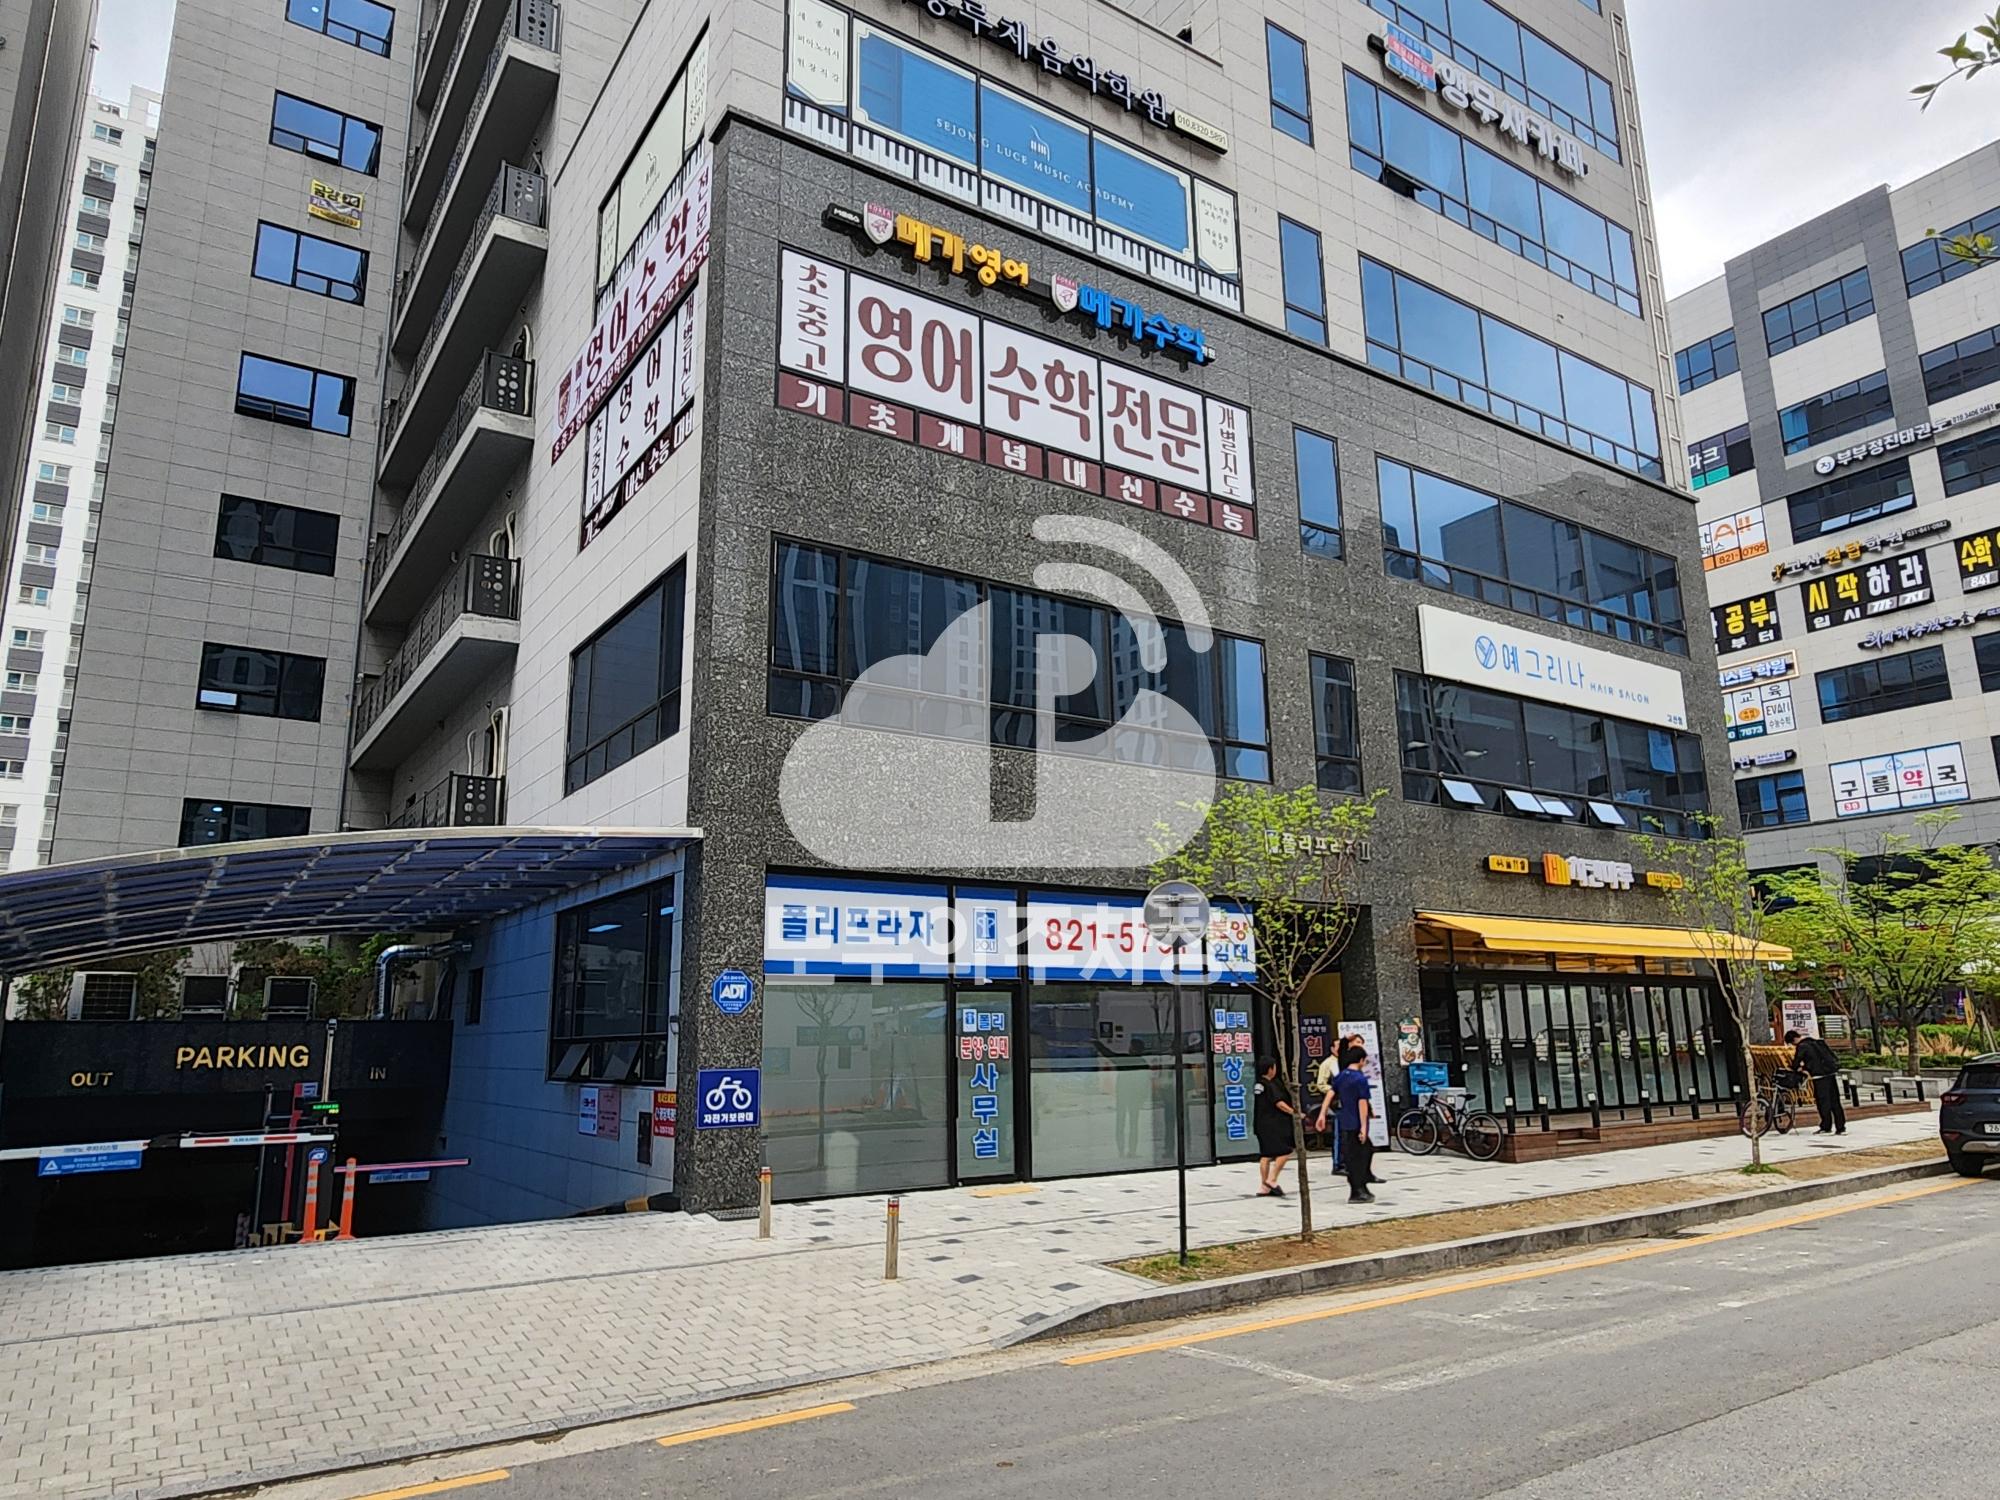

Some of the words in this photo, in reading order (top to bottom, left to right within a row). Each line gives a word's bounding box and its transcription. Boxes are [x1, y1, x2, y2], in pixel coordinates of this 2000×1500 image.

[936, 117, 990, 149] SEJONG
[996, 143, 1028, 166] LUCE
[1033, 159, 1071, 185] MUSIC
[1076, 178, 1135, 211] ACADEMY
[895, 212, 1030, 287] 메가영어
[795, 263, 829, 376] 초중고
[1078, 283, 1206, 364] 메가수학
[619, 337, 662, 424] 영어
[857, 295, 974, 405] 영어
[986, 345, 1096, 443] 수학
[1106, 378, 1202, 476] 전문
[615, 393, 660, 475] 수학
[1218, 404, 1243, 498] 개별지도
[1836, 419, 1950, 467] 부부정진태권도
[1718, 542, 1767, 565] 821-0795
[1808, 554, 1924, 614] 시작하라
[1501, 643, 1585, 689] 예그리나
[1590, 682, 1614, 696] HAIR
[1618, 689, 1650, 705] SALON
[782, 903, 935, 947] 폴리프라자
[1046, 917, 1188, 955] 821-57
[1213, 943, 1250, 964] 임대
[720, 983, 747, 1000] ADT
[977, 1012, 1005, 1031] 폴리
[71, 1072, 113, 1087] OUT
[176, 1045, 310, 1070] PARKING
[370, 1066, 386, 1080] IN
[703, 1111, 754, 1124] 자전거보관대
[970, 1062, 999, 1159] 사무실
[1222, 1055, 1249, 1141] 상담실
